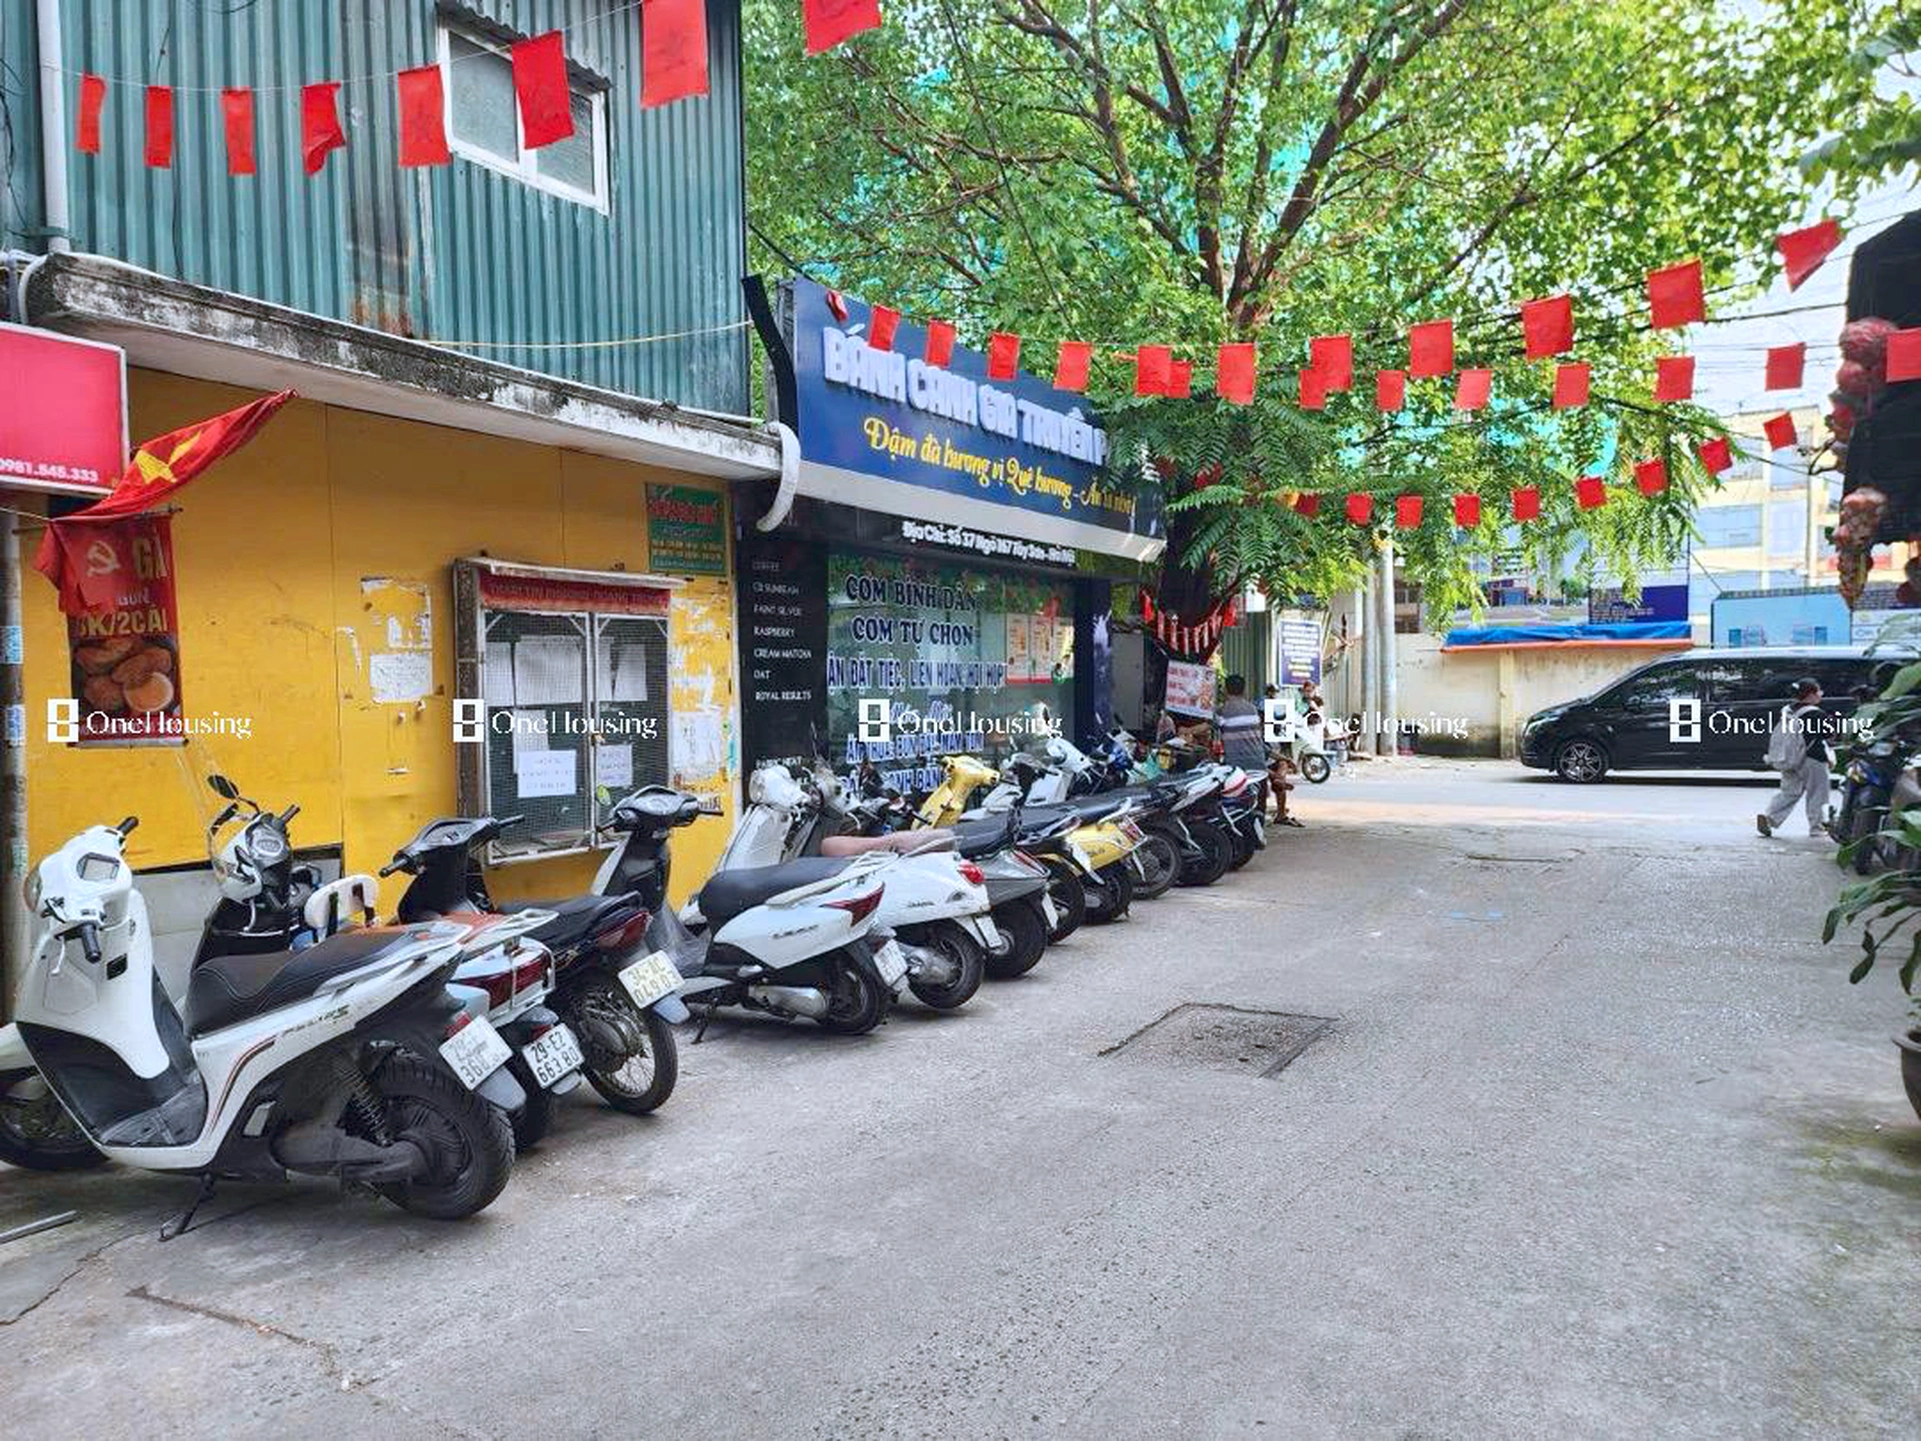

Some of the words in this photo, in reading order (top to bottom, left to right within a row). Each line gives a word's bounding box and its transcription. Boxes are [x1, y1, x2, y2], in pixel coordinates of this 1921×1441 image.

[823, 323, 905, 402] BÁNH
[864, 417, 916, 461] Đậm
[753, 670, 771, 680] OAT
[755, 690, 780, 701] ROYAL
